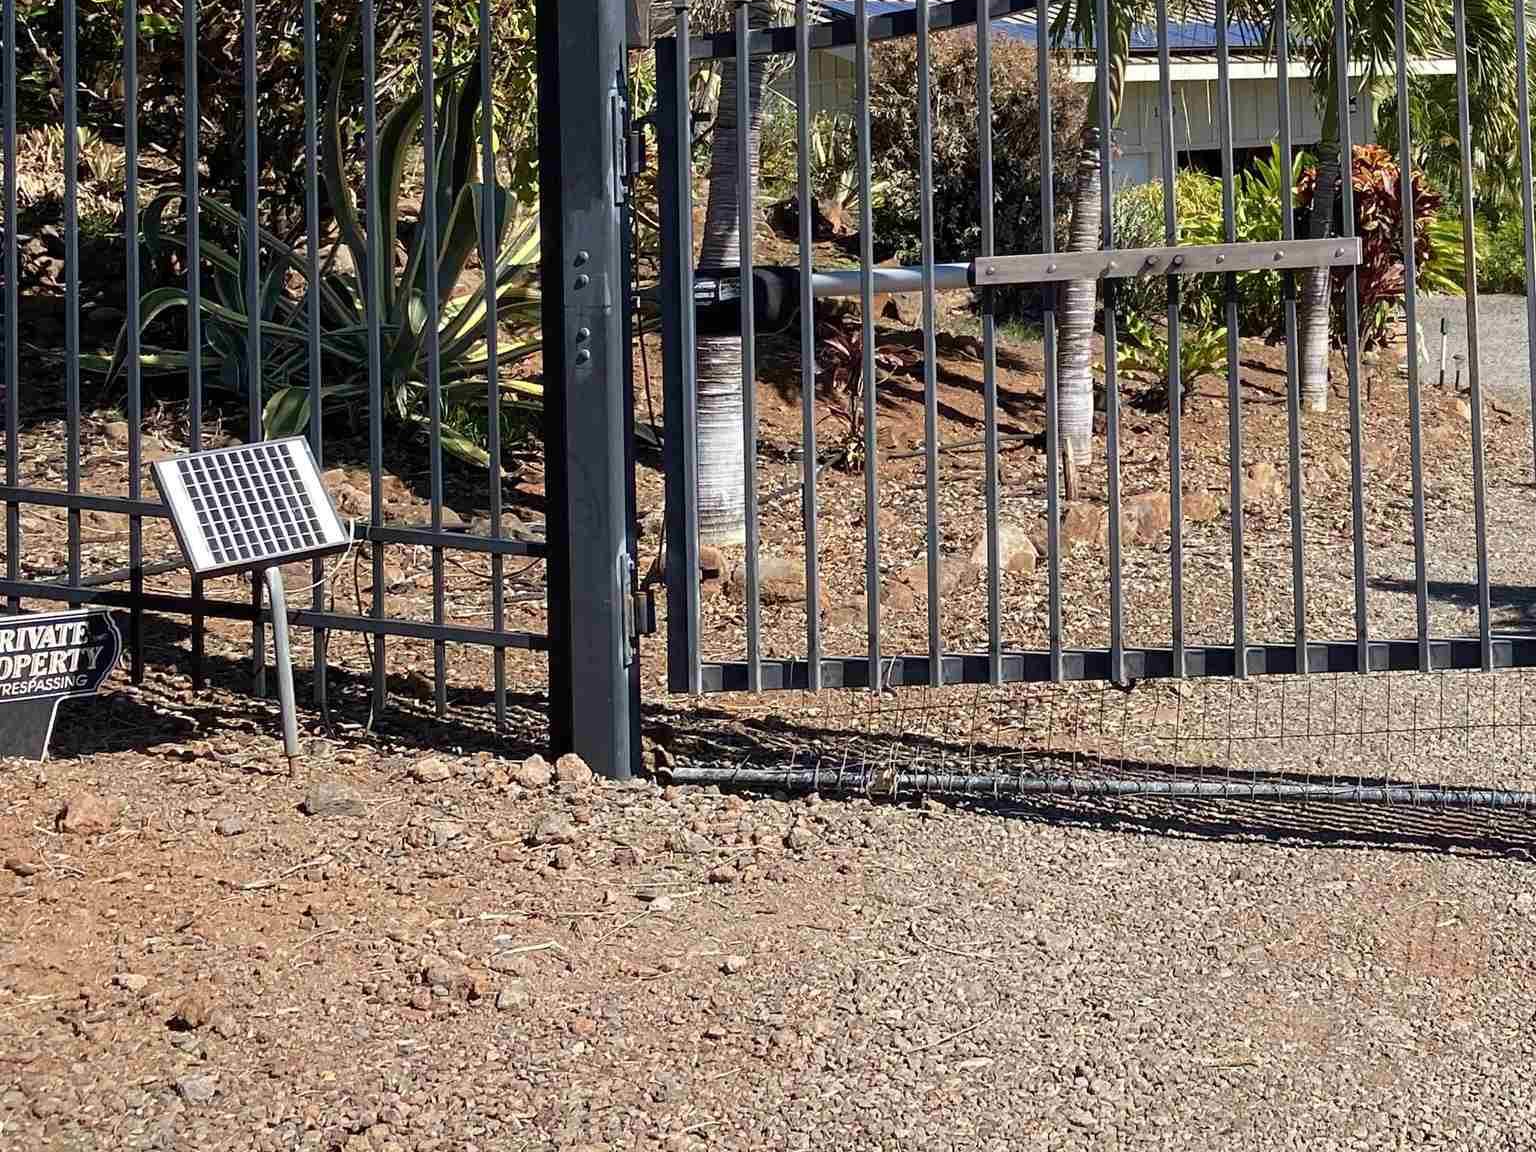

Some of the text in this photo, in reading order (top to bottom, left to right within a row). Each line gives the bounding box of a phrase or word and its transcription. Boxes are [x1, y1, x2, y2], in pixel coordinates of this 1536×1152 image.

[0, 621, 89, 653] RIVATE
[0, 645, 103, 681] OPERTY
[0, 674, 89, 697] RESPASSING
